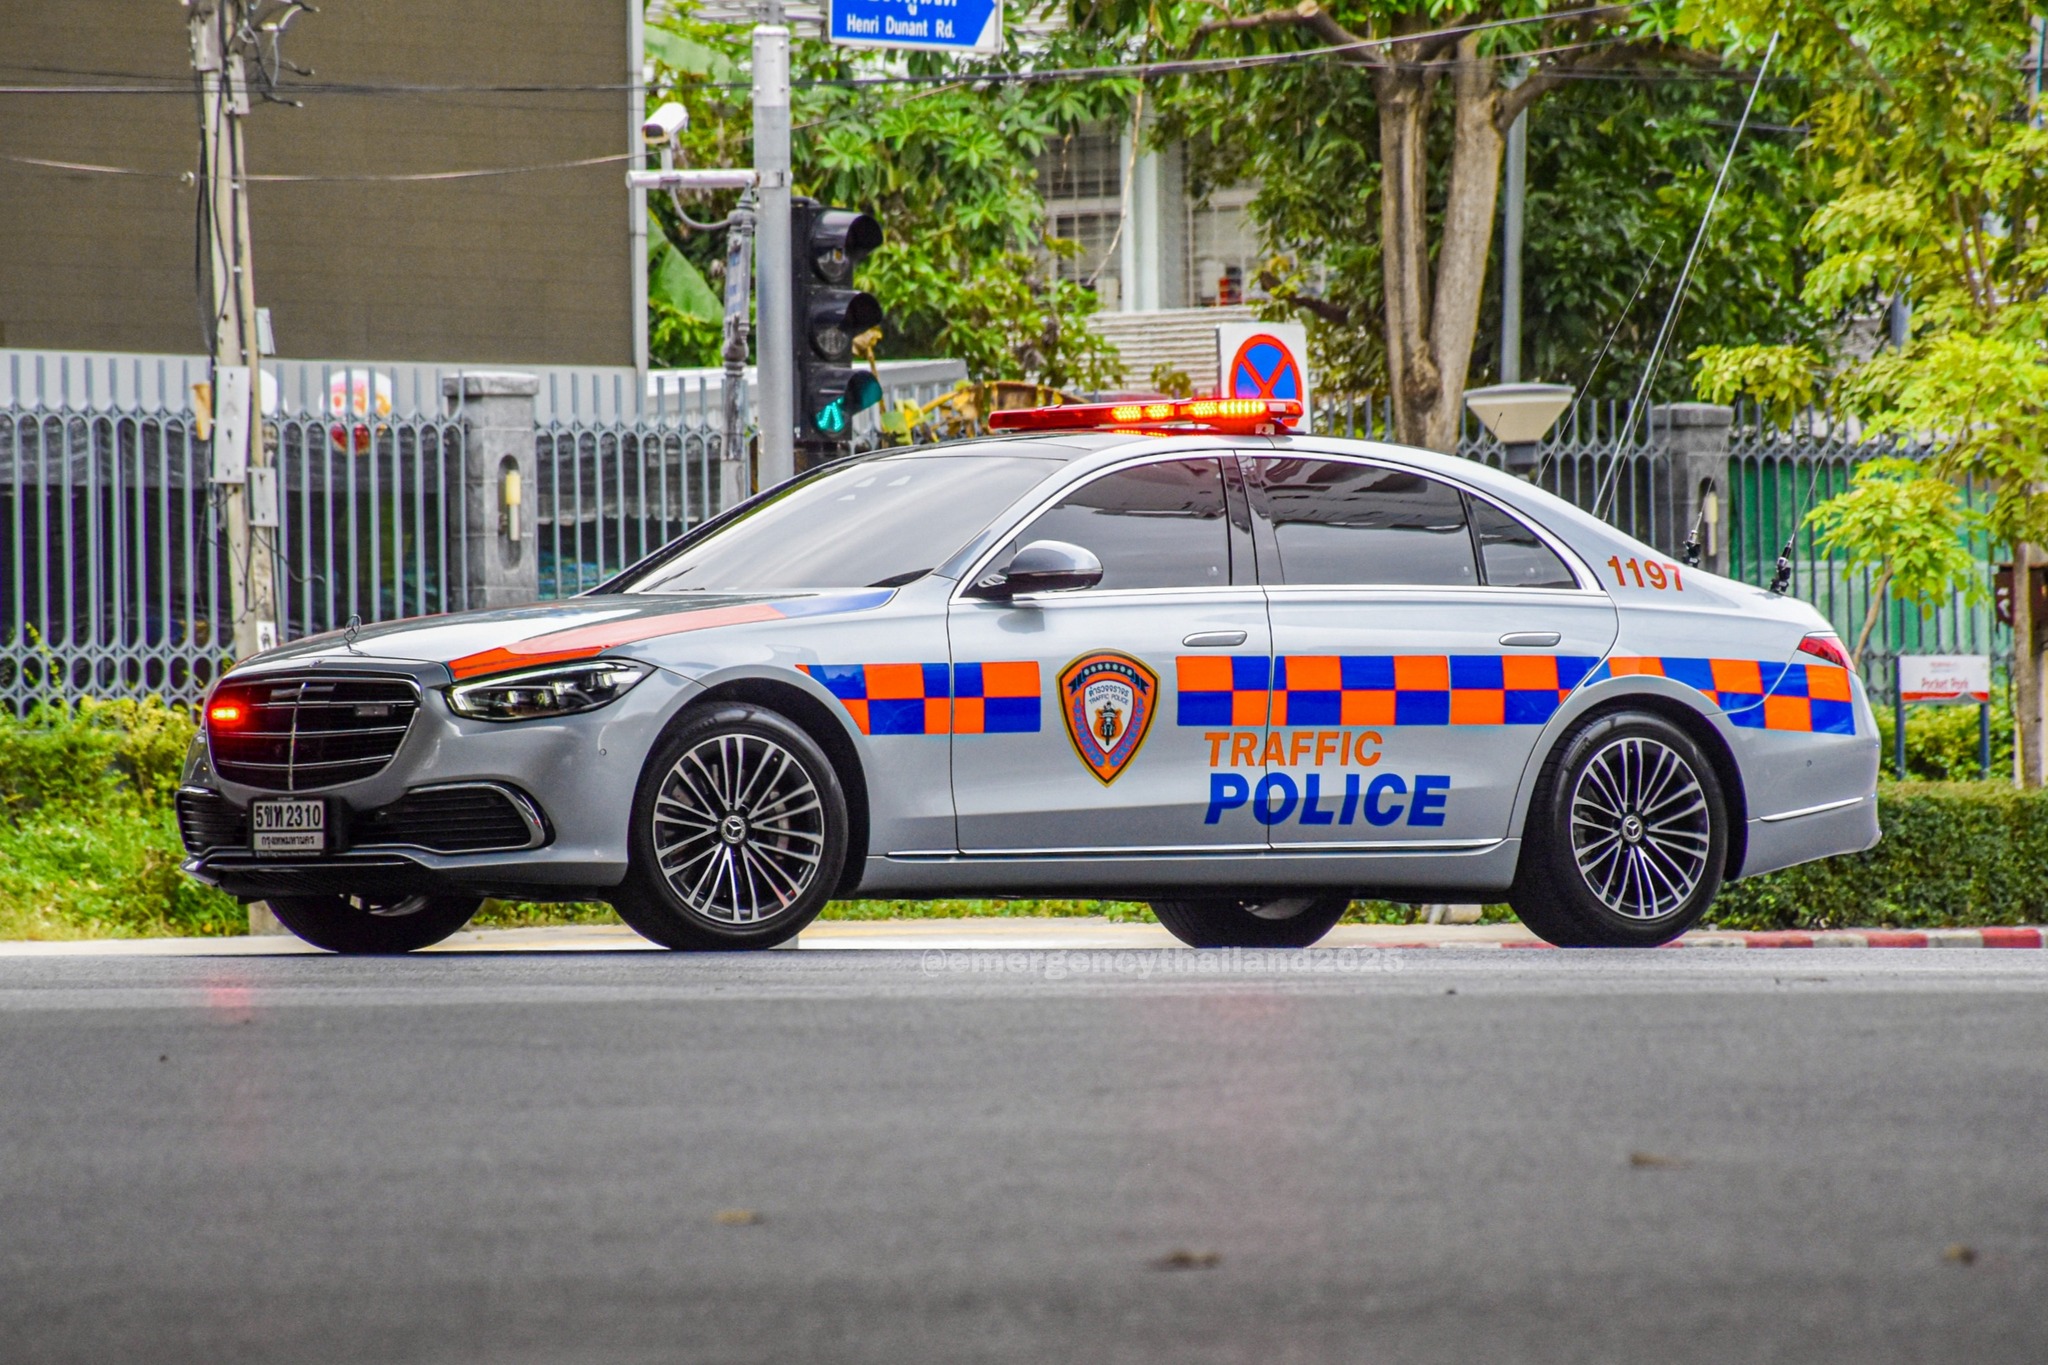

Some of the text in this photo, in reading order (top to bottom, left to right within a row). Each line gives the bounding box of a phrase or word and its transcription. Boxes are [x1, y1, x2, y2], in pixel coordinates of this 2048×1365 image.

[847, 13, 956, 38] Henri Dunant Rd.
[1607, 555, 1683, 592] 1197
[1088, 684, 1130, 697] ตำรวจจราจร
[1089, 693, 1130, 706] TRAFFIC POLICE
[1204, 730, 1383, 767] TRAFFIC
[1204, 772, 1450, 827] POLICE
[286, 804, 321, 828] 2310
